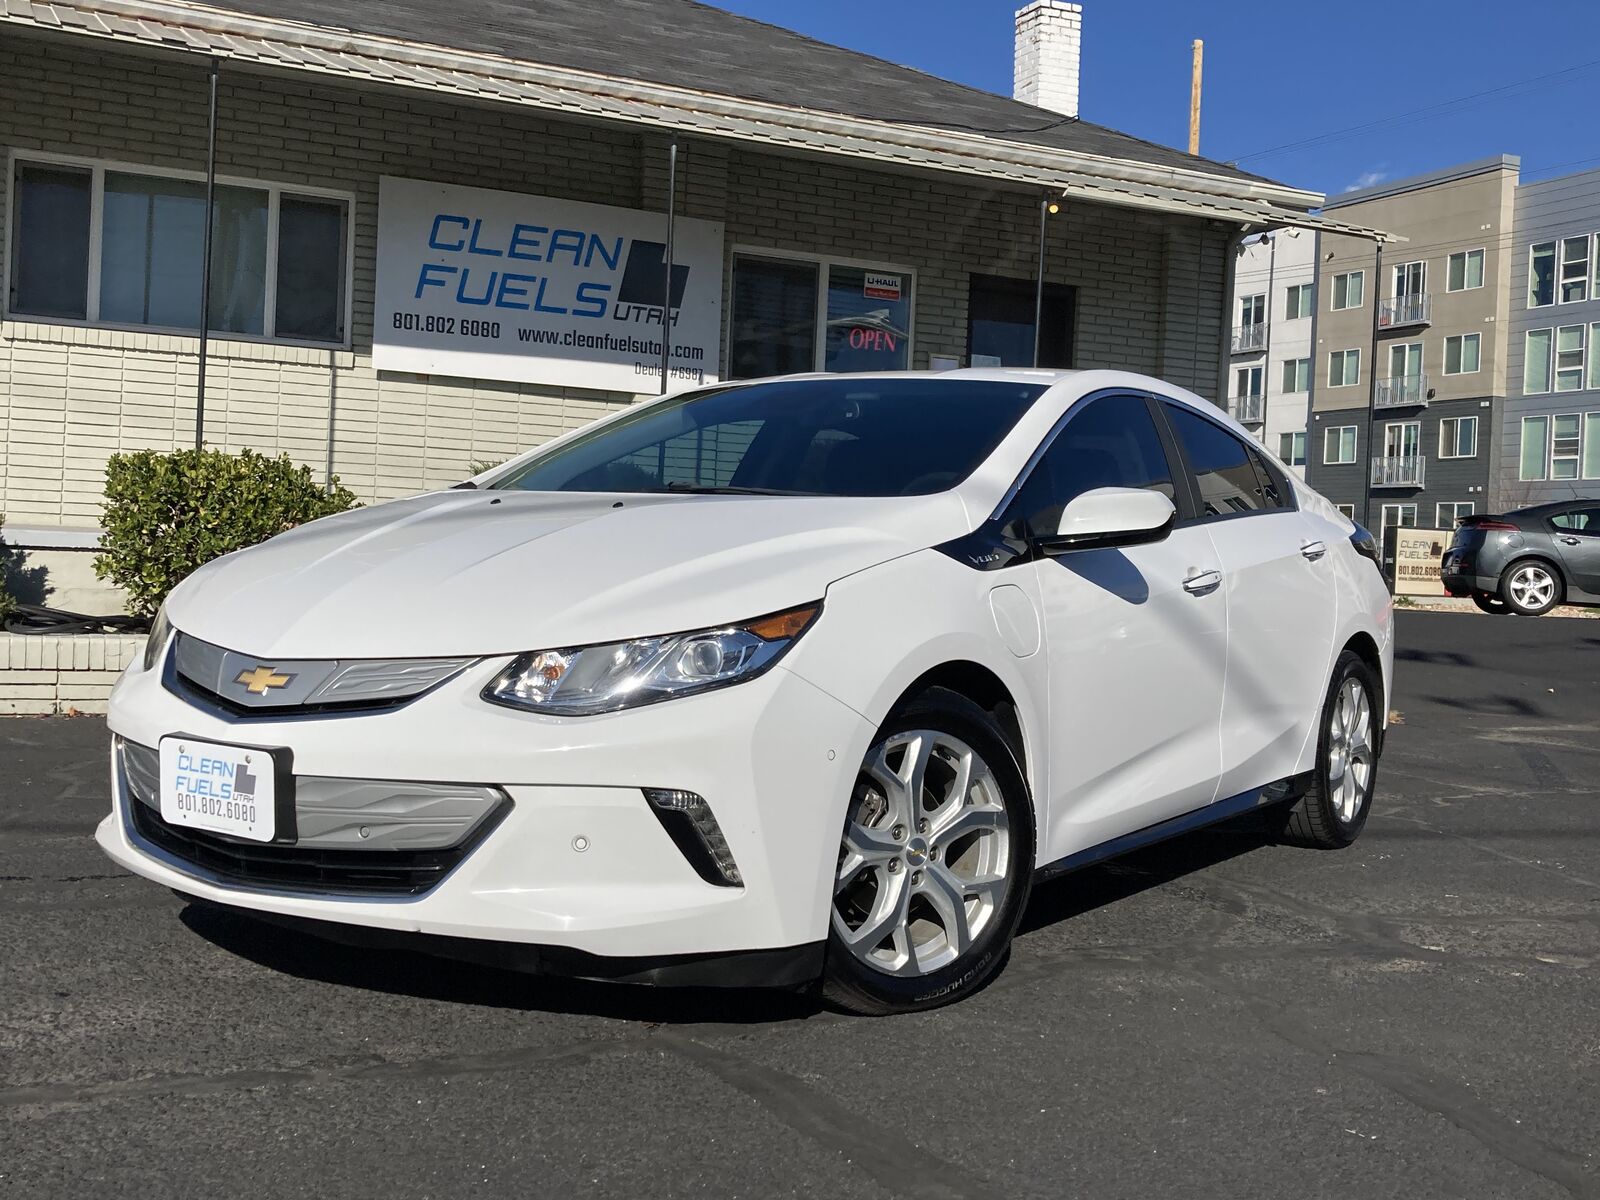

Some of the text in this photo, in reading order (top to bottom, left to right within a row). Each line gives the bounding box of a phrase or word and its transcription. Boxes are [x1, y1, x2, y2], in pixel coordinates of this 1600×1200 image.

[428, 214, 624, 271] CLEAN
[415, 263, 612, 318] FUELS
[867, 276, 898, 288] U-HAUL
[393, 312, 500, 339] 801.802 6080
[613, 303, 680, 327] UTAH
[518, 327, 704, 361] www.cleanfuelsuta.com
[850, 328, 897, 352] OPEN
[634, 362, 704, 382] Deale #6987
[1398, 551, 1429, 560] FUELS
[1401, 540, 1431, 549] CLEAN
[178, 755, 234, 777] CLEAN
[176, 776, 232, 799] FUELS
[232, 793, 254, 804] UTAH
[178, 793, 256, 822] 801.802.6080
